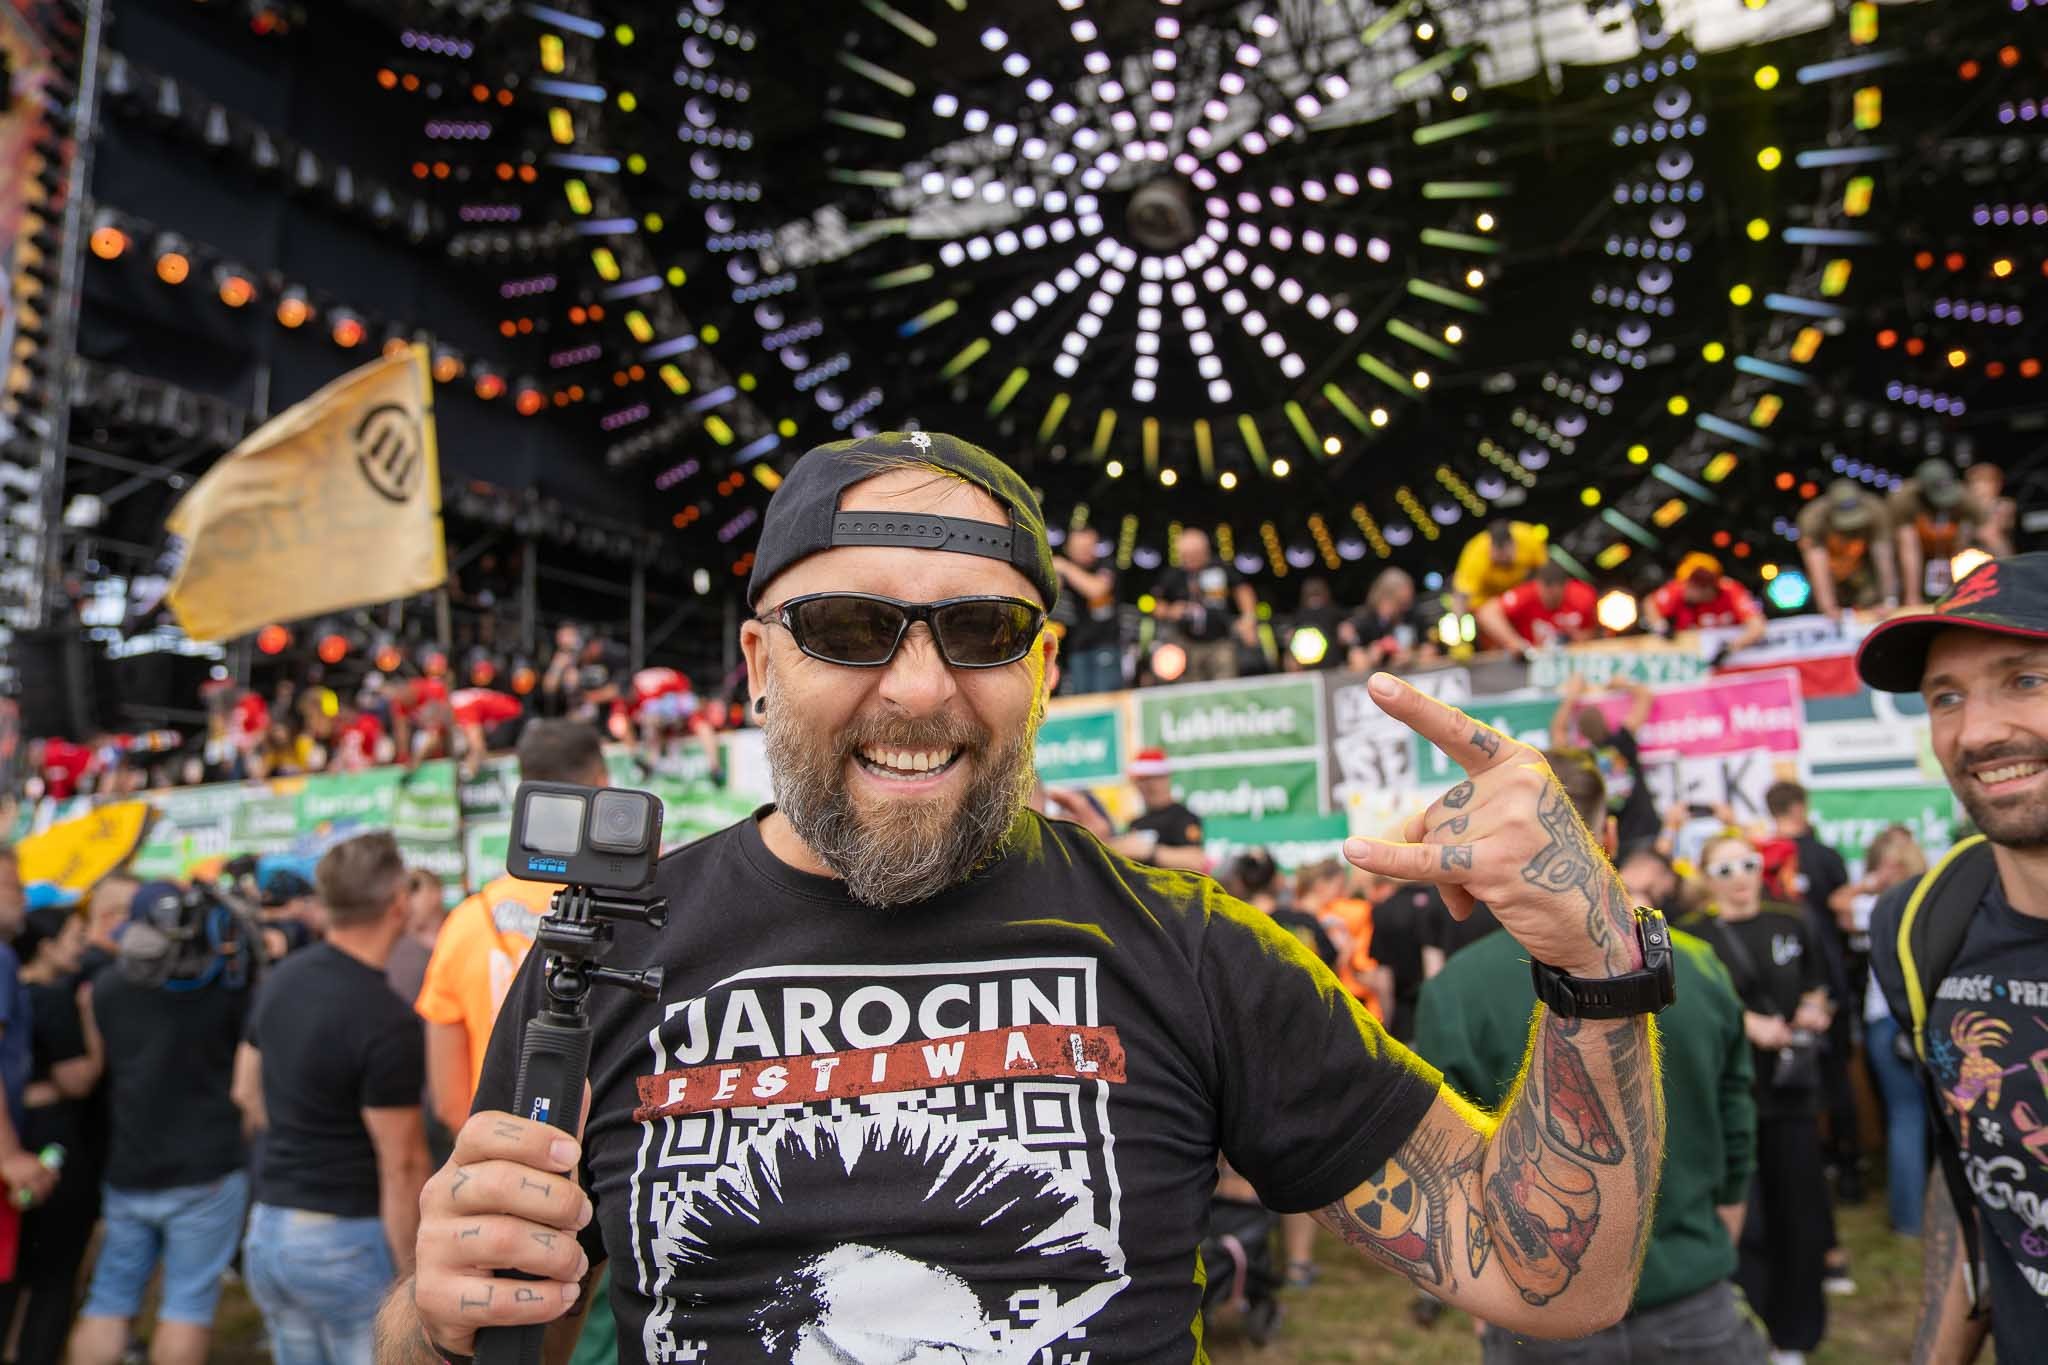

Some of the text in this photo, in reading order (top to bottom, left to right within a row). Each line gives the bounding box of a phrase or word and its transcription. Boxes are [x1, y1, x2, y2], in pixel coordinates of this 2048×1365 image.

[528, 856, 569, 866] GoPro
[674, 977, 1077, 1065] JAROCIN
[659, 1031, 1099, 1109] FESTIWAL
[530, 1096, 542, 1121] Pro
